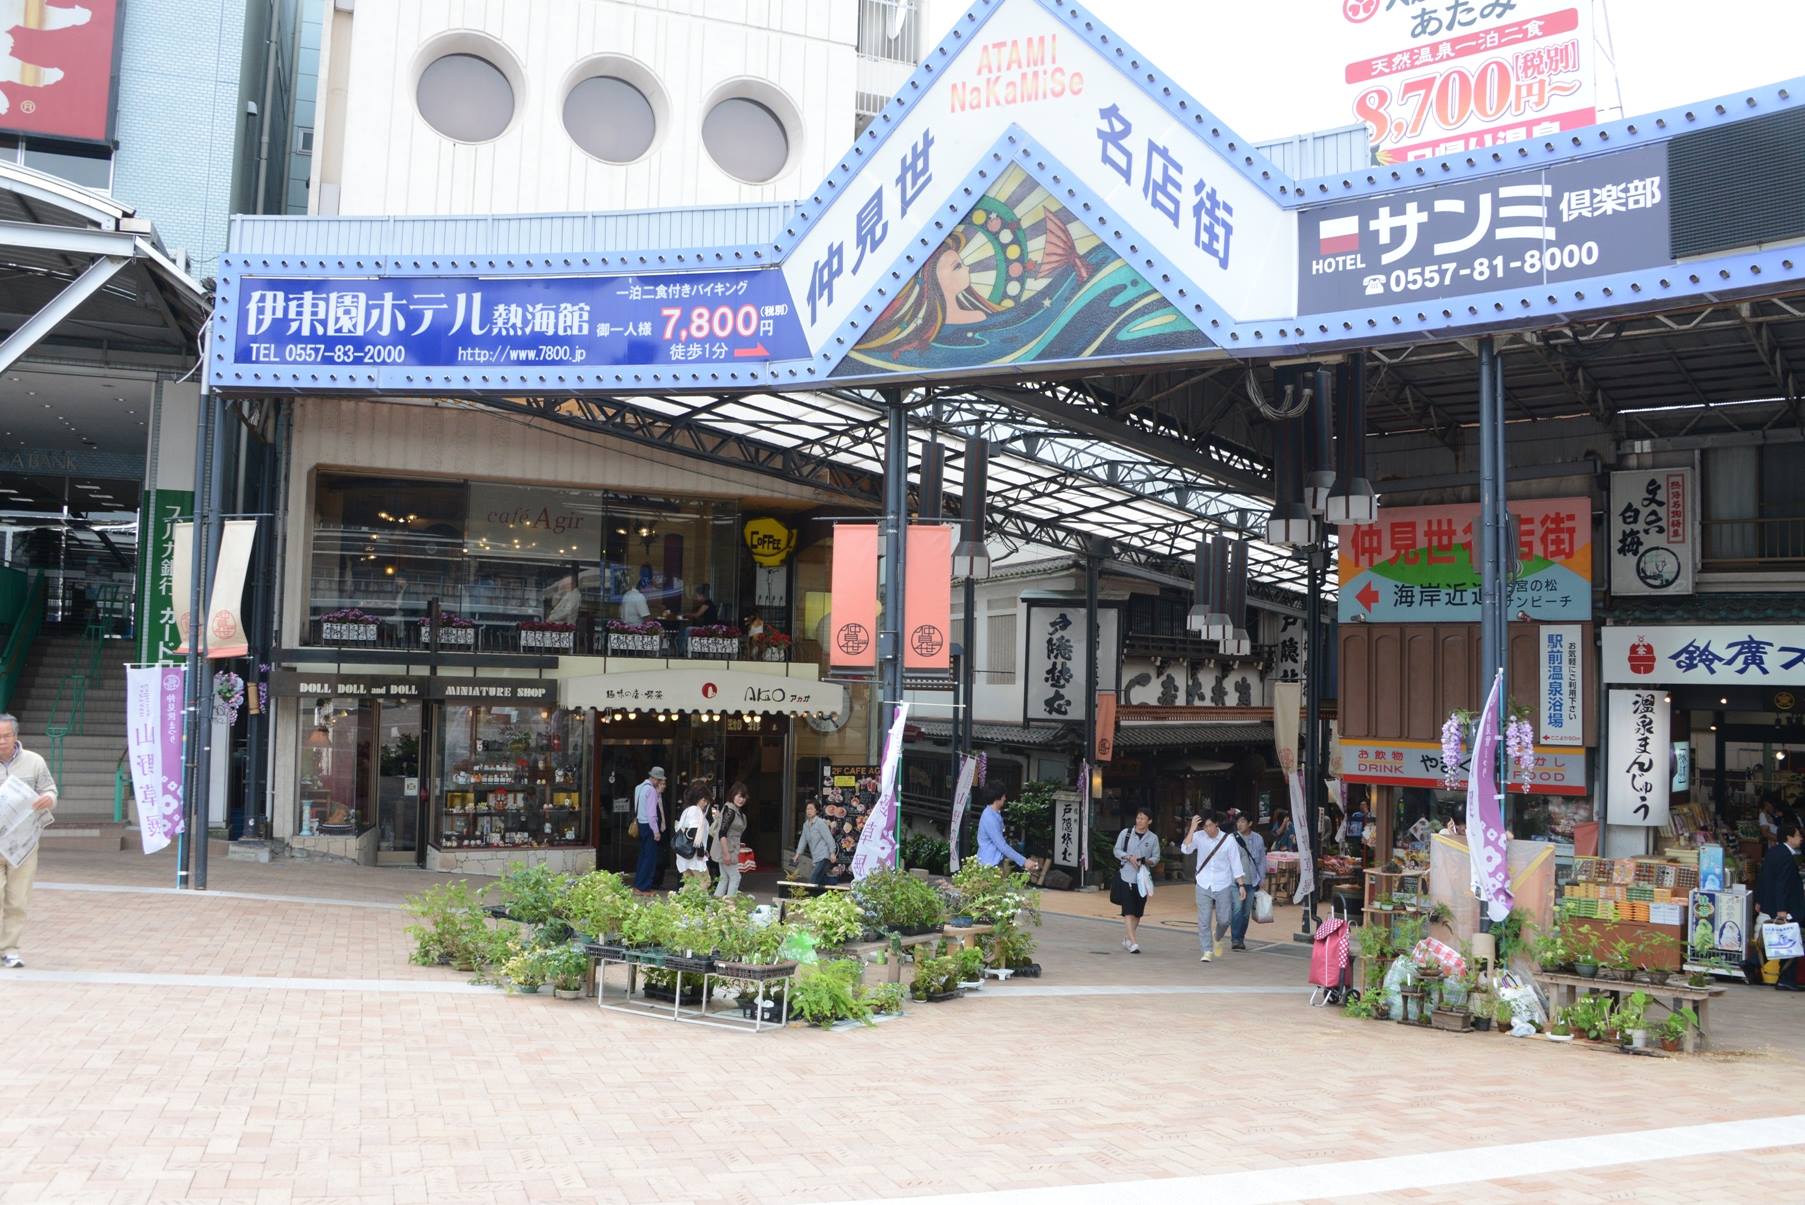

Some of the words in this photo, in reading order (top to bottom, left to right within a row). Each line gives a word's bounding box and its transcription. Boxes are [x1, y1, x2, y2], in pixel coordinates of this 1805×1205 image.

[976, 34, 1057, 76] ATAMI
[1370, 20, 1545, 76] 天然温泉一泊二食
[1096, 103, 1233, 271] 名店街
[807, 128, 935, 328] 仲見世
[1311, 253, 1366, 276] HOTEL
[1389, 240, 1599, 293] 0557-81-8000
[616, 279, 748, 300] 一泊二食付きバイキング
[250, 343, 280, 362] TEL
[285, 344, 405, 363] 0557-83-2000
[458, 345, 586, 364] http://www.7800.jp
[669, 343, 728, 360] 徒歩1分
[299, 682, 331, 694] DOLL
[337, 683, 367, 694] DOLL
[371, 686, 386, 695] and
[390, 684, 418, 695] DOLL
[1547, 633, 1563, 728] 駅前温泉浴場
[445, 685, 511, 697] MINIATURE
[517, 687, 546, 698] SHOP
[1358, 749, 1404, 761] お飲物
[843, 767, 867, 775] CAFE
[1358, 763, 1404, 774] DRINK
